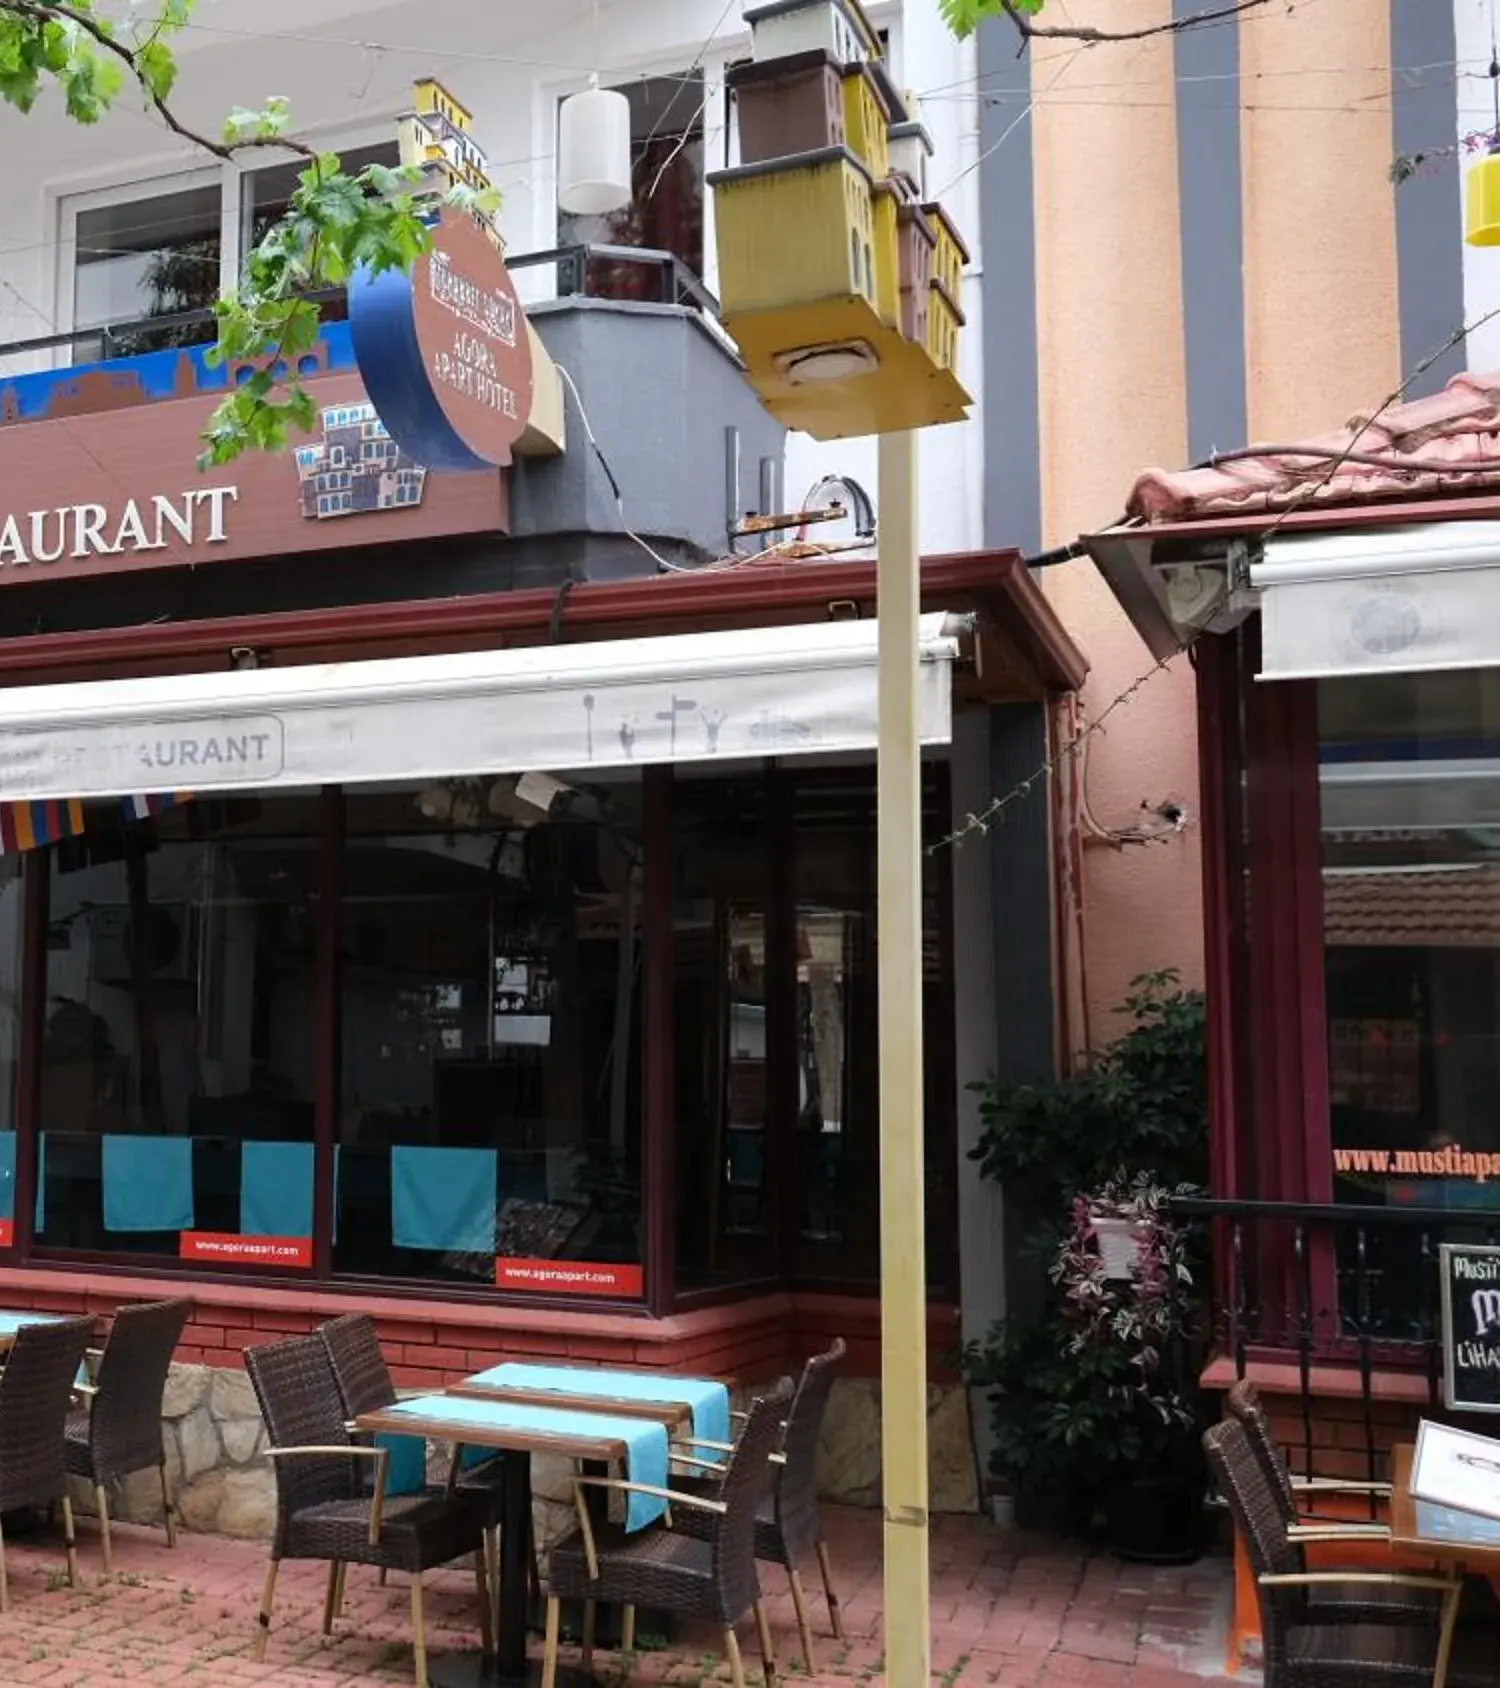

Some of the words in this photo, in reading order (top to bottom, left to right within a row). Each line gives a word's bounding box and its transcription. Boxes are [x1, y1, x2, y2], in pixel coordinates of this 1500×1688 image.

[454, 331, 498, 378] AGORA
[434, 352, 473, 395] APART
[476, 371, 518, 420] HOTEL
